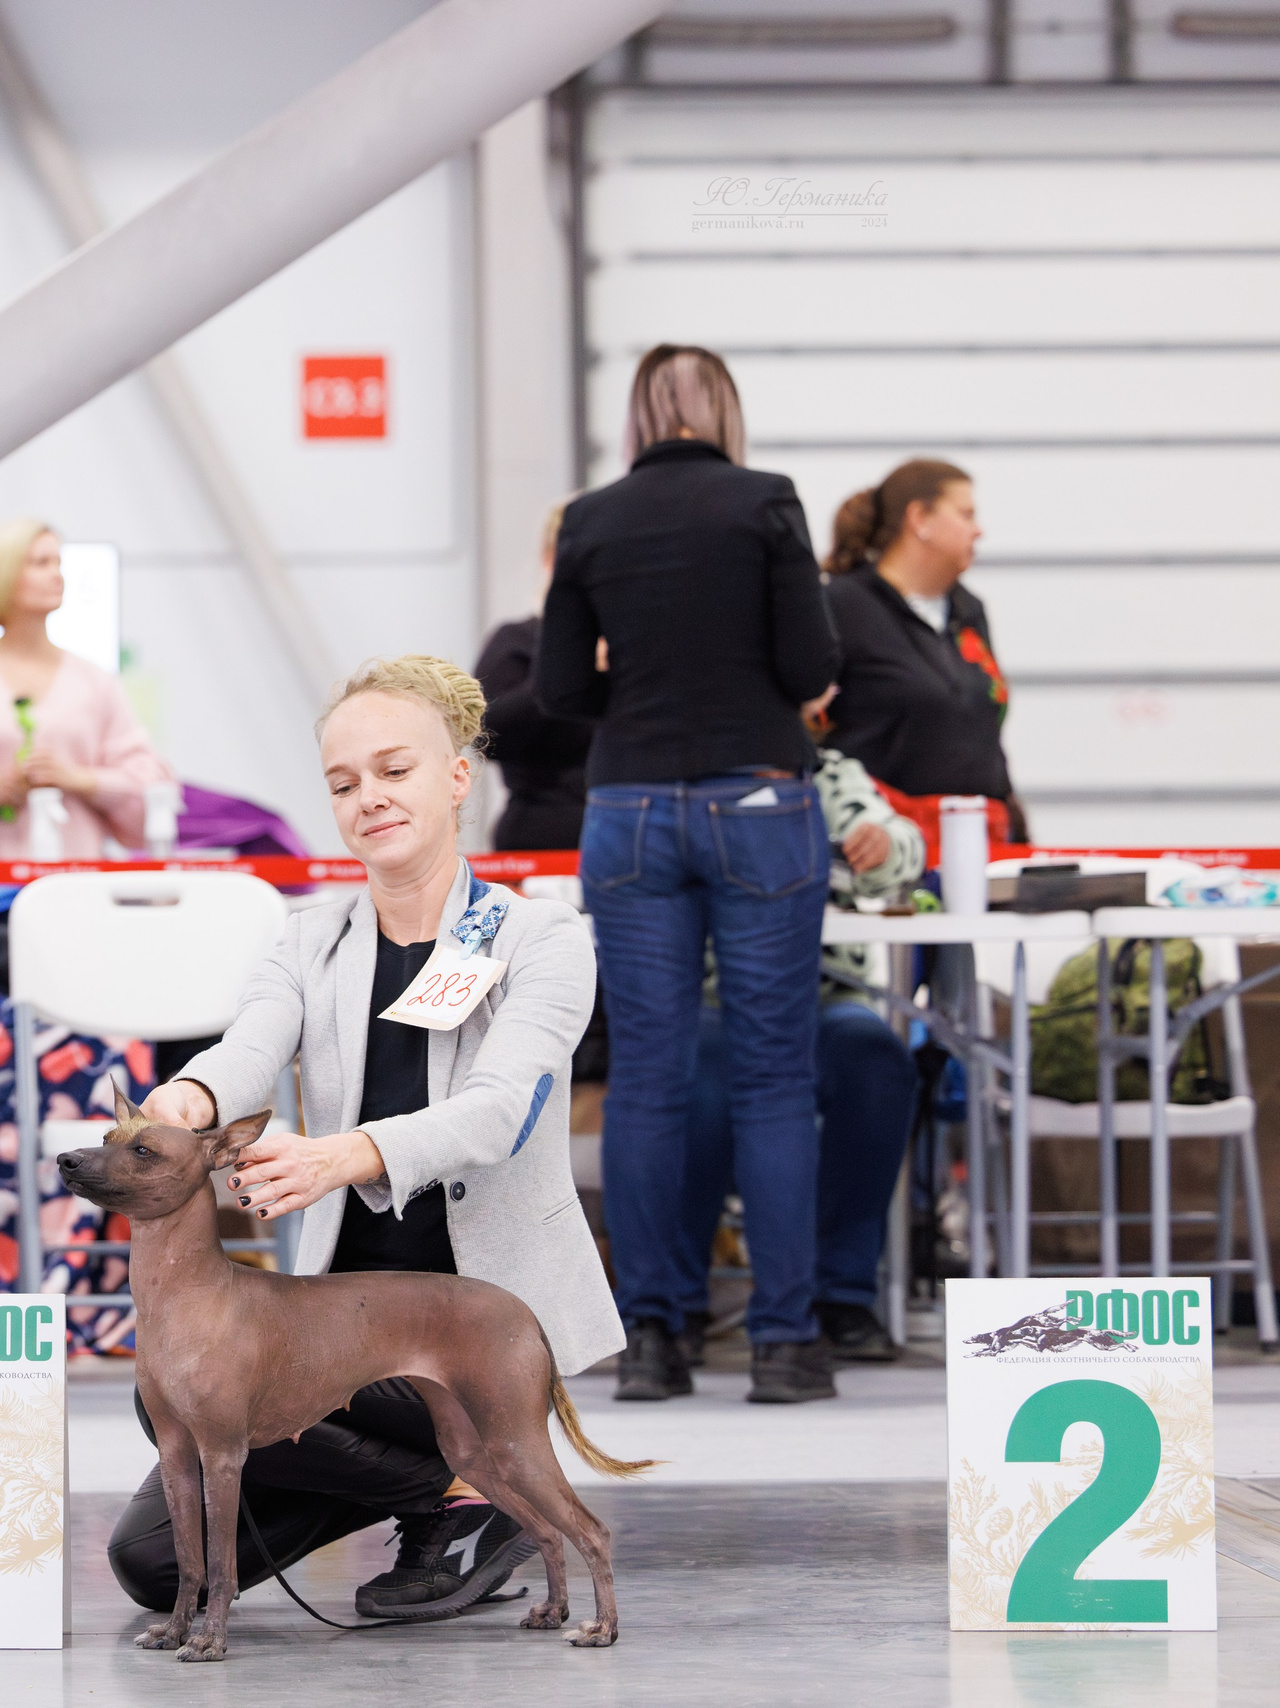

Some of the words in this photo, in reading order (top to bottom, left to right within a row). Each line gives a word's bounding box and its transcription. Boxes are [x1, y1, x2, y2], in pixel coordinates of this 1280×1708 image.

[406, 972, 478, 1007] 283
[1066, 1289, 1200, 1346] РФОС
[996, 1356, 1051, 1364] ФЕДЕРАЦИЯ
[1053, 1356, 1121, 1364] ОХОТНИЧЬЕГО
[1122, 1355, 1201, 1364] СОБАКОВОДСТВА
[1004, 1379, 1168, 1623] 2
